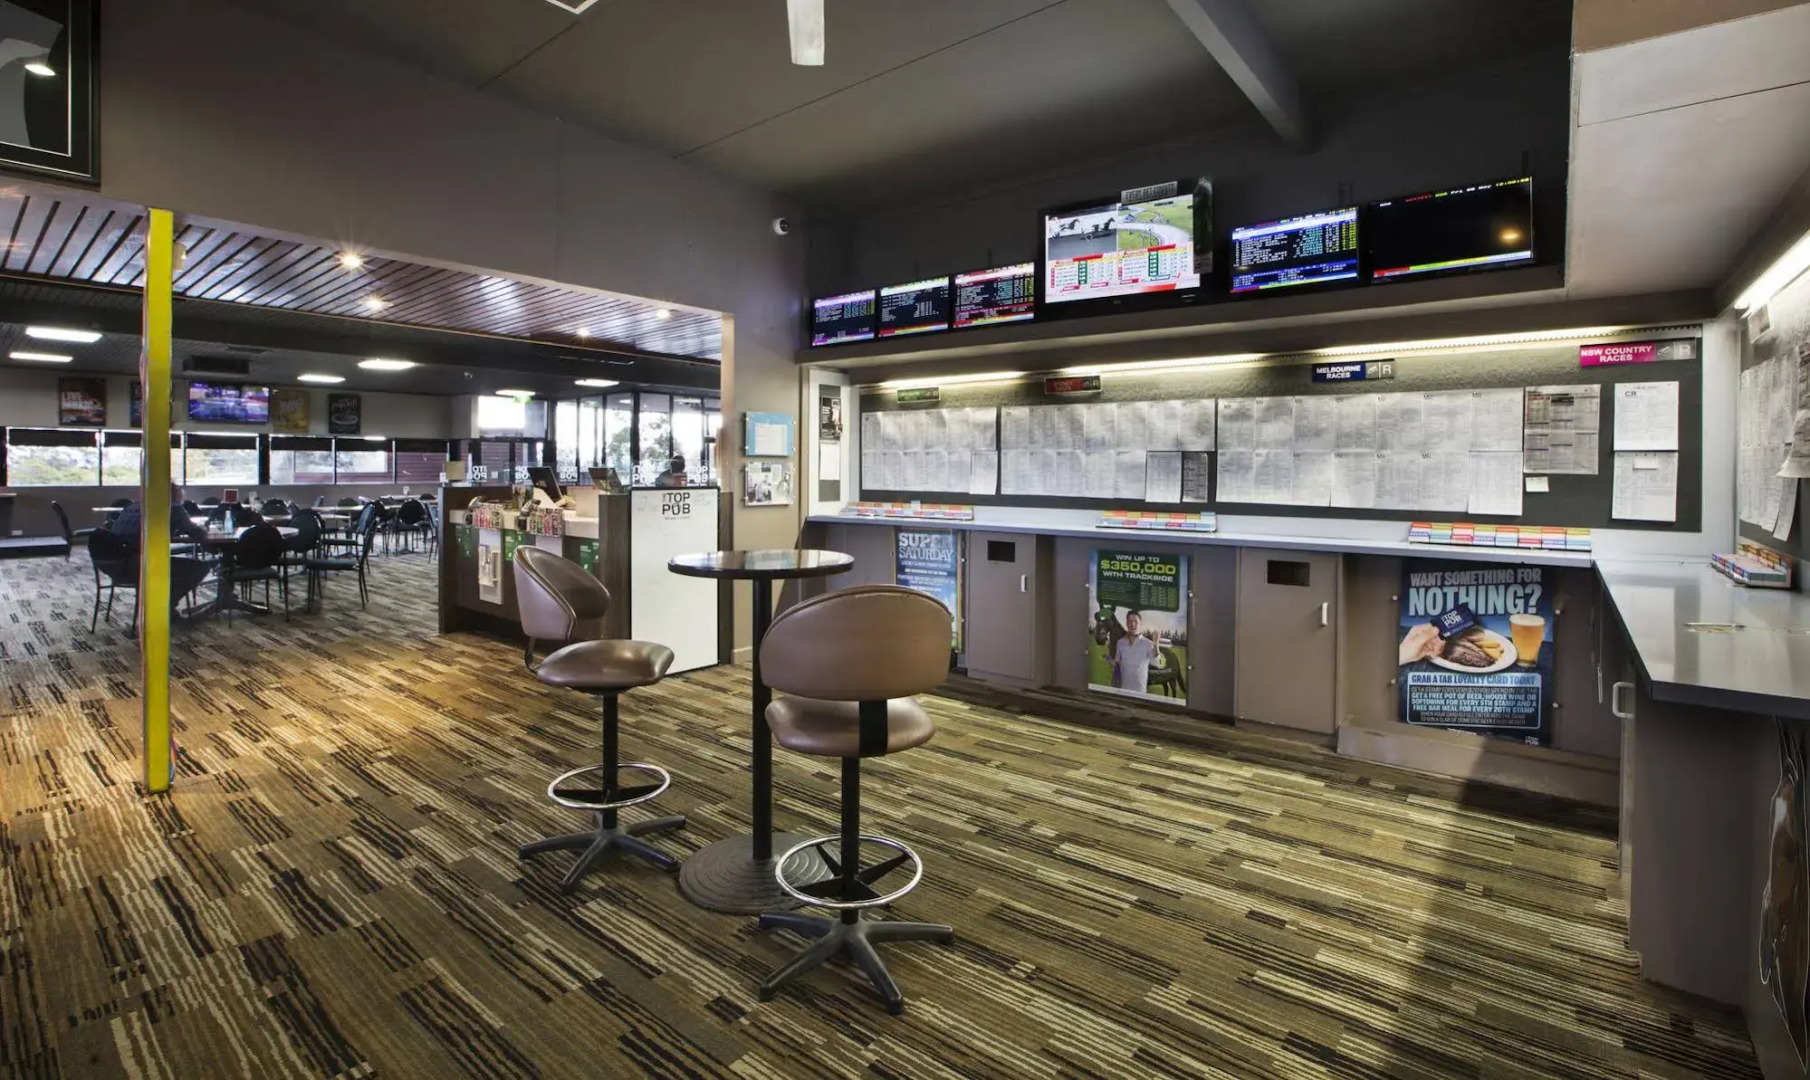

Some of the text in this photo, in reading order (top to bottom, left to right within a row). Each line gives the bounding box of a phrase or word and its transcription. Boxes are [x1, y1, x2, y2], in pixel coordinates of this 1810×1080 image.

[1581, 344, 1691, 357] NSW COUNTRY R
[1599, 354, 1633, 362] RACES
[1316, 364, 1392, 375] MELBOURNE R
[666, 492, 691, 503] TOP
[662, 503, 691, 515] PUB
[899, 547, 953, 561] SATURDAY
[1133, 554, 1146, 562] UP
[1101, 559, 1176, 575] $350,000
[1102, 570, 1174, 582] WITH TRACKSIDE
[1410, 567, 1542, 587] WANT SOMETHING FOR
[1408, 583, 1542, 617] NOTHING?
[1412, 674, 1536, 685] GRAB A TAB LOYALTY CARD TODAY
